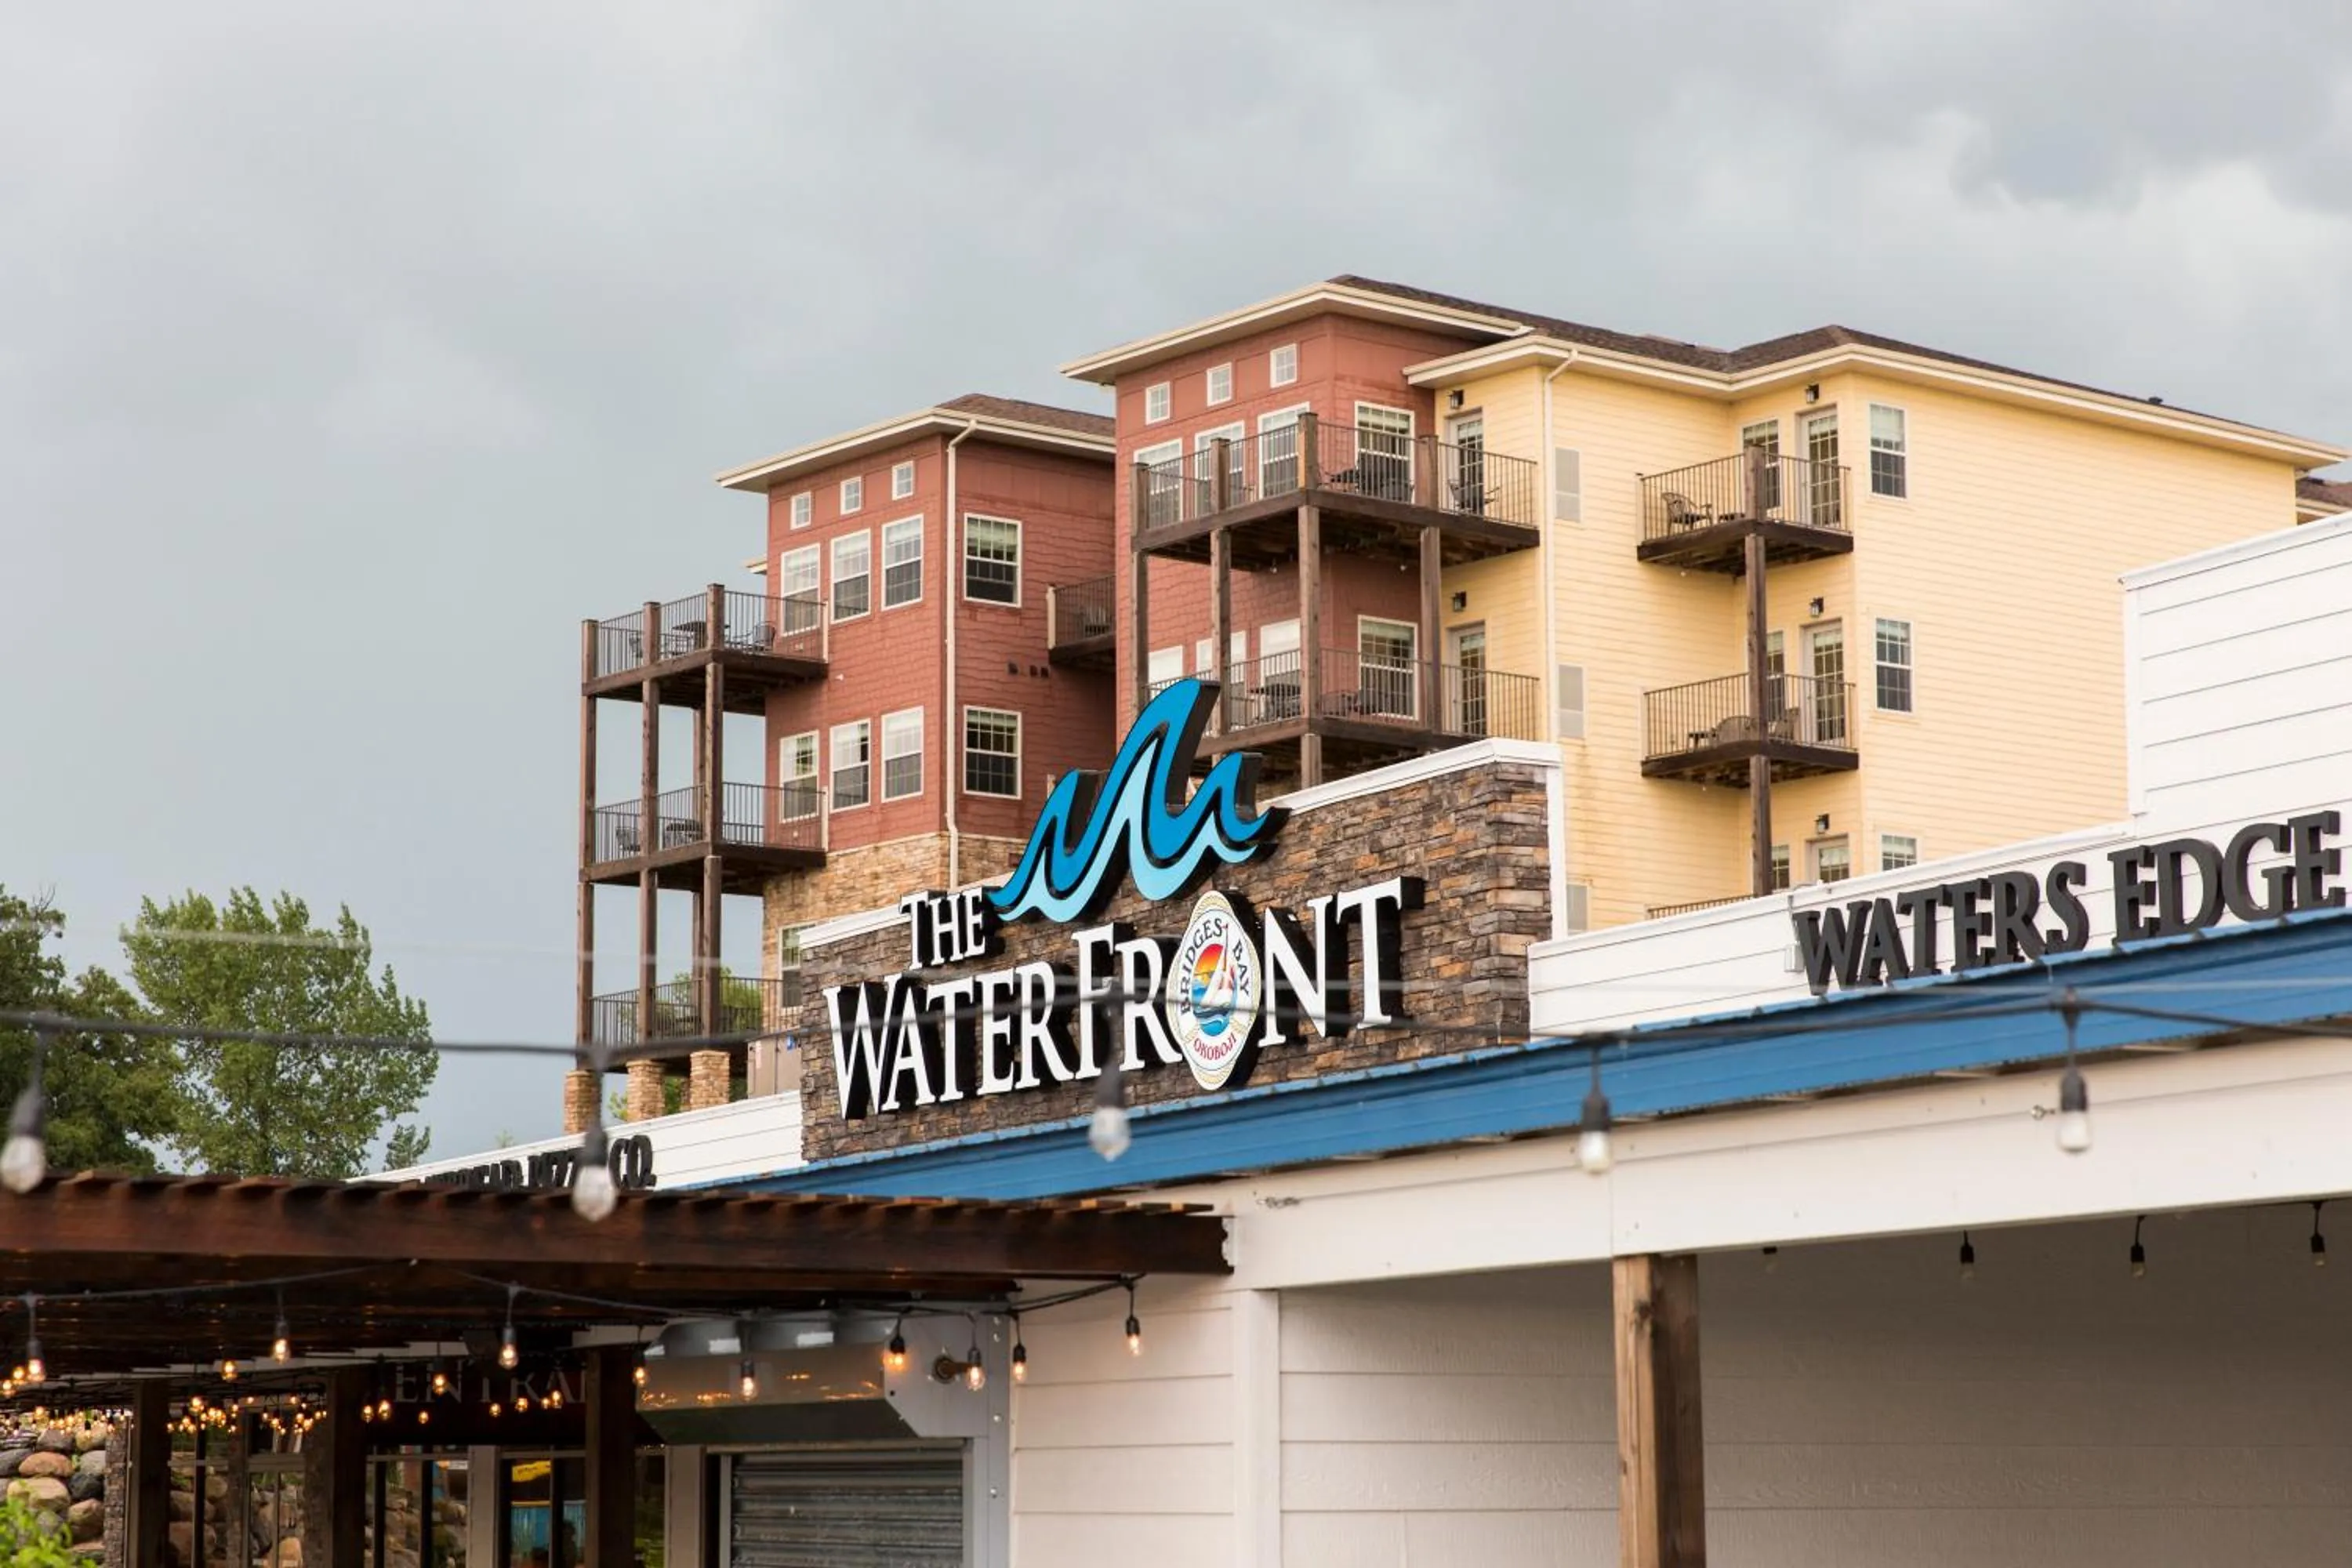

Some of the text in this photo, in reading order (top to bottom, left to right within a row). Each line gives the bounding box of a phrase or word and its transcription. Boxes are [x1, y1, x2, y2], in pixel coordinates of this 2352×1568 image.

[901, 887, 986, 970] THE
[1791, 811, 2346, 996] WATERS EDGE
[1180, 918, 1250, 1014] BRIDGES BAY
[1193, 1032, 1236, 1061] OKOBOJI
